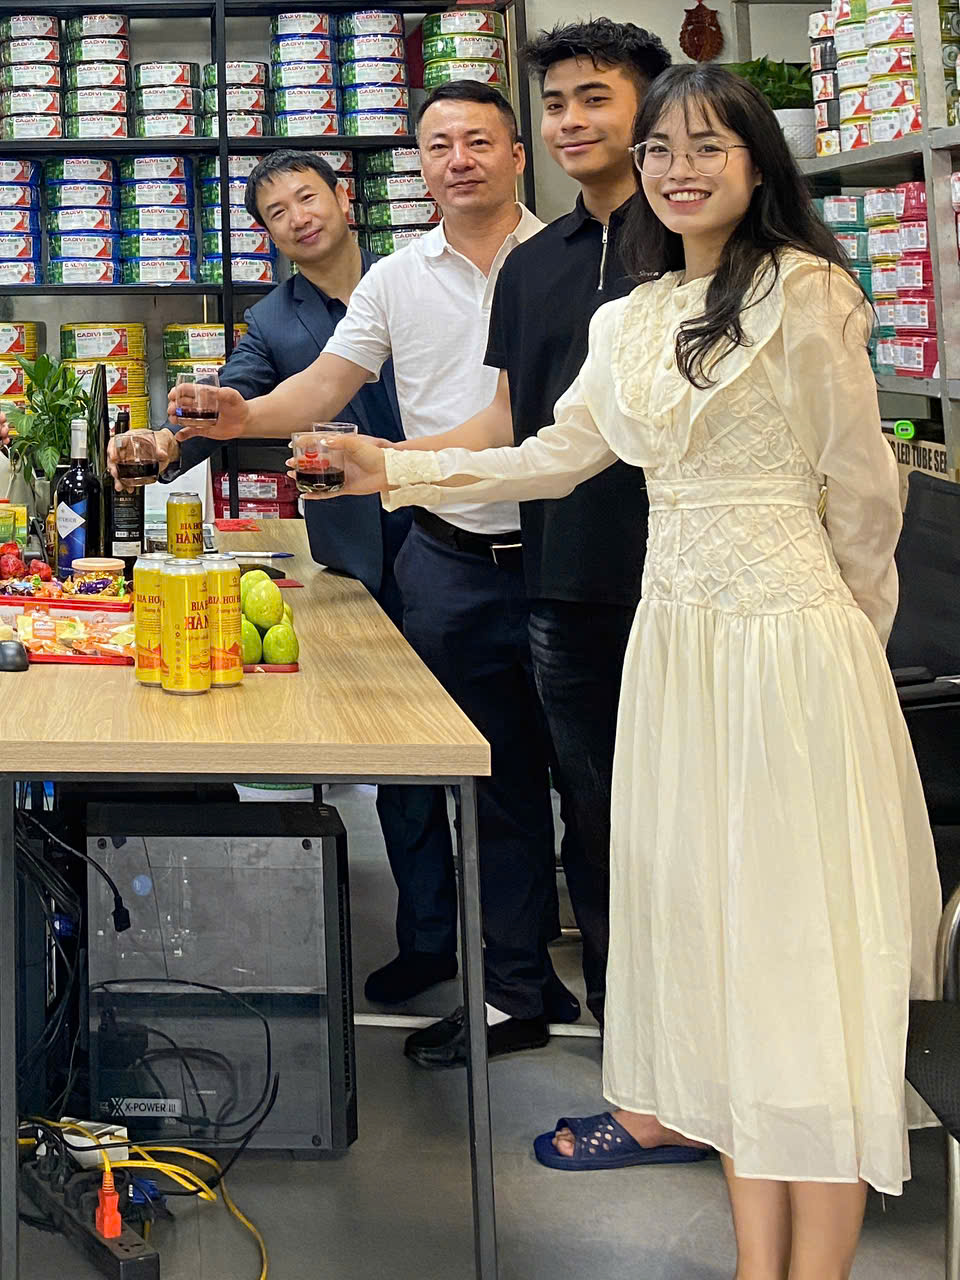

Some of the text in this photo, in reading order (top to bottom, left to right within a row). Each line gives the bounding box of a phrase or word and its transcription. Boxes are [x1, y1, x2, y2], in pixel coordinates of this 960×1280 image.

[897, 442, 910, 465] LED
[912, 445, 932, 470] TUBE
[176, 529, 190, 544] HÀ
[208, 596, 220, 604] BIA
[191, 602, 205, 611] BIA
[184, 613, 204, 630] HÀ
[125, 1103, 166, 1112] X-POWER
